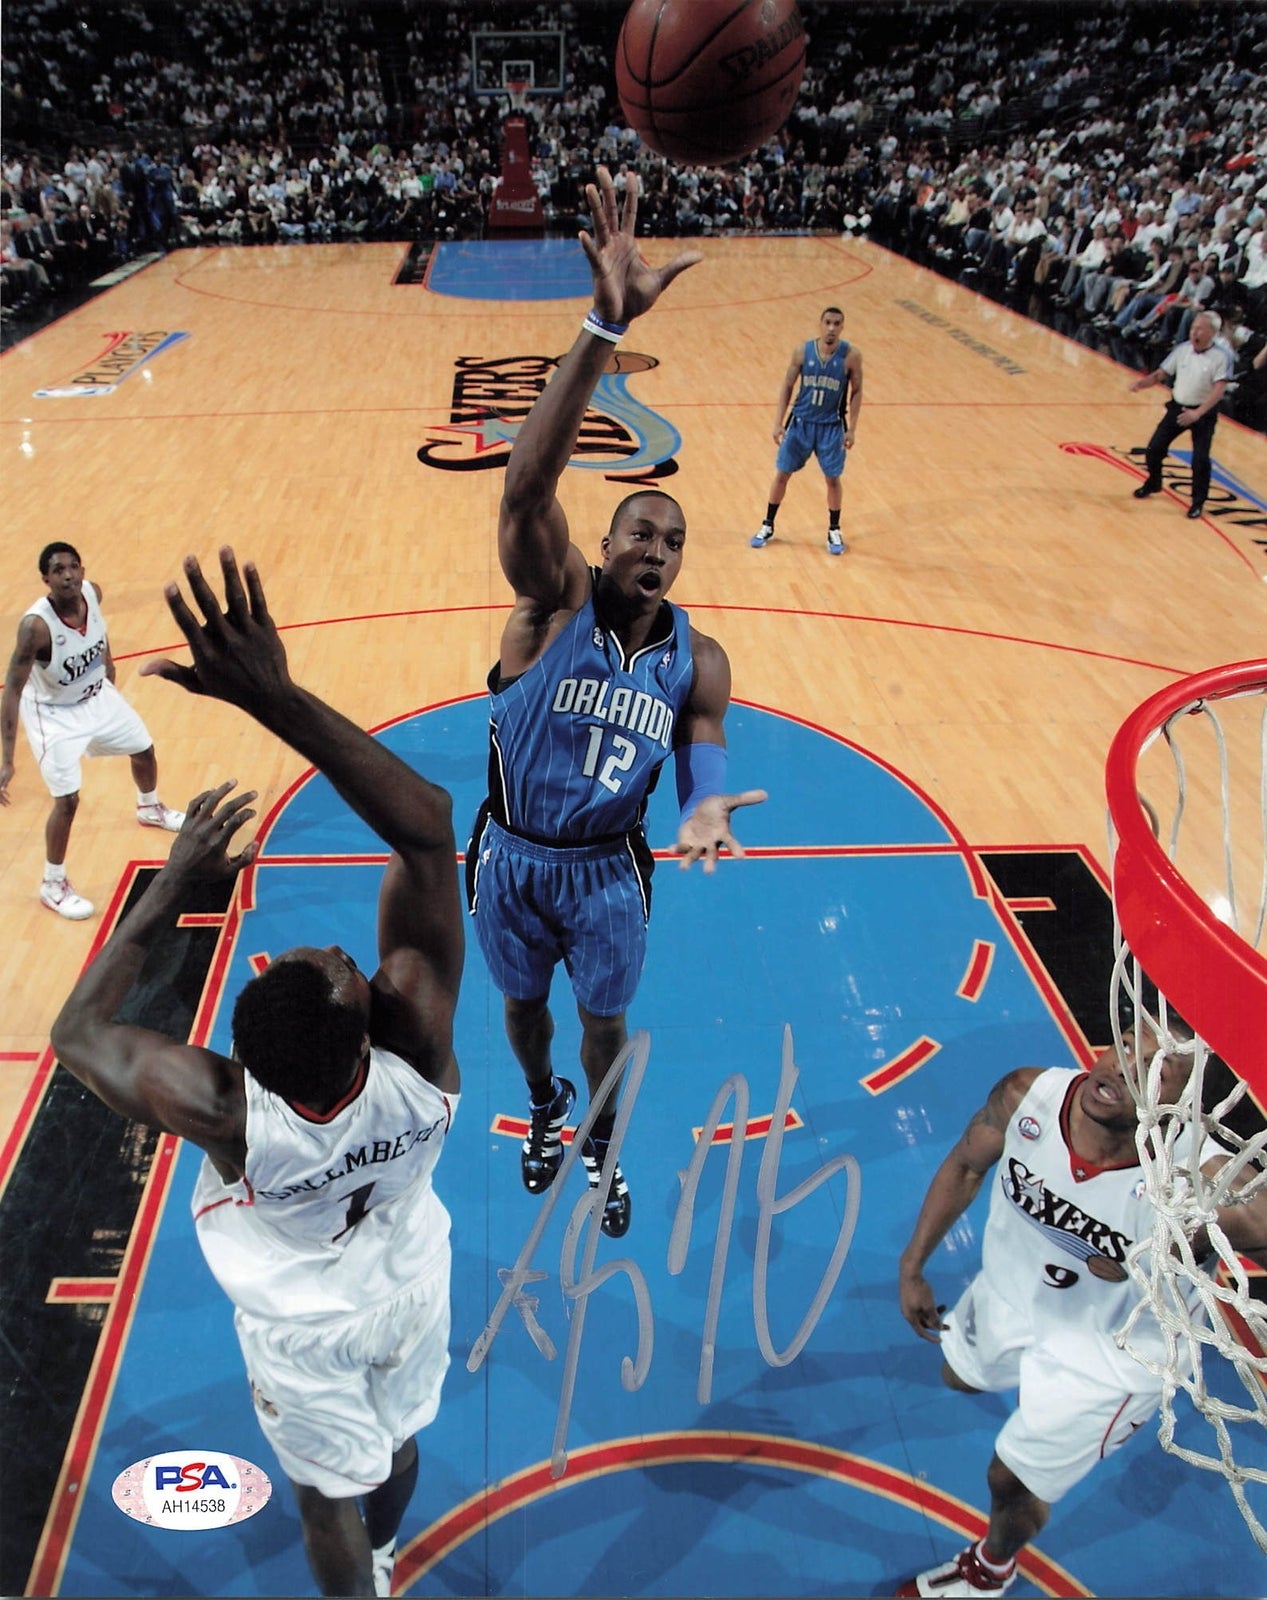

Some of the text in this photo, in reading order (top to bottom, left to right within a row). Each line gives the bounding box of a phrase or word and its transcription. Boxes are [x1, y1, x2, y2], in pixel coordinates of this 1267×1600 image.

[803, 375, 840, 391] ORLANDO
[812, 389, 824, 406] 11
[552, 678, 673, 749] ORLANDO
[582, 725, 637, 794] 12
[332, 1181, 376, 1243] 1
[1002, 1157, 1134, 1263] SIXERS
[1043, 1263, 1079, 1289] 9
